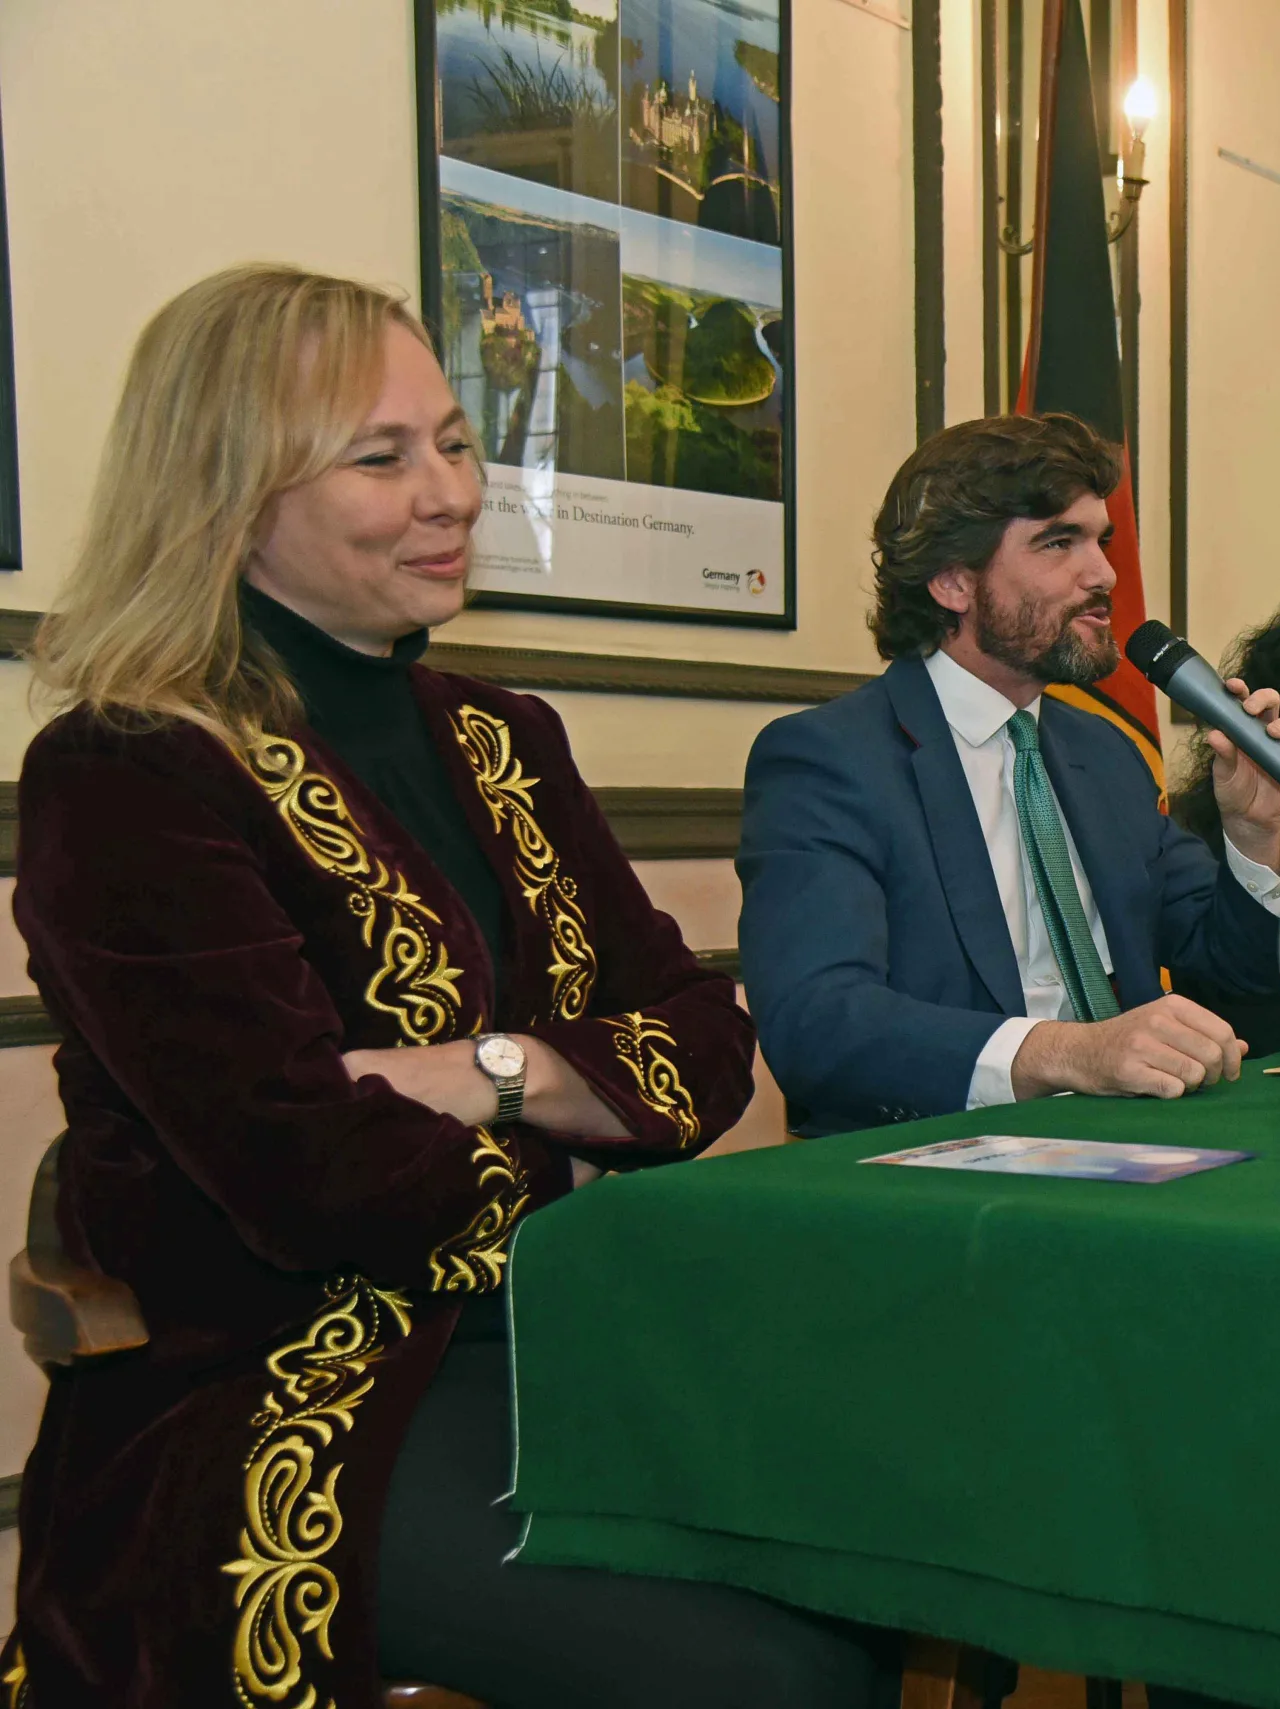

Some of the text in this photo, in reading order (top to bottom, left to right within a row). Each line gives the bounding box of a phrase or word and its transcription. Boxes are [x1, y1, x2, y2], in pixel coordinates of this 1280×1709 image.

[498, 497, 518, 514] the
[557, 505, 569, 520] in
[573, 505, 640, 529] Destination
[642, 514, 695, 538] Germany.
[702, 568, 740, 585] Germany
